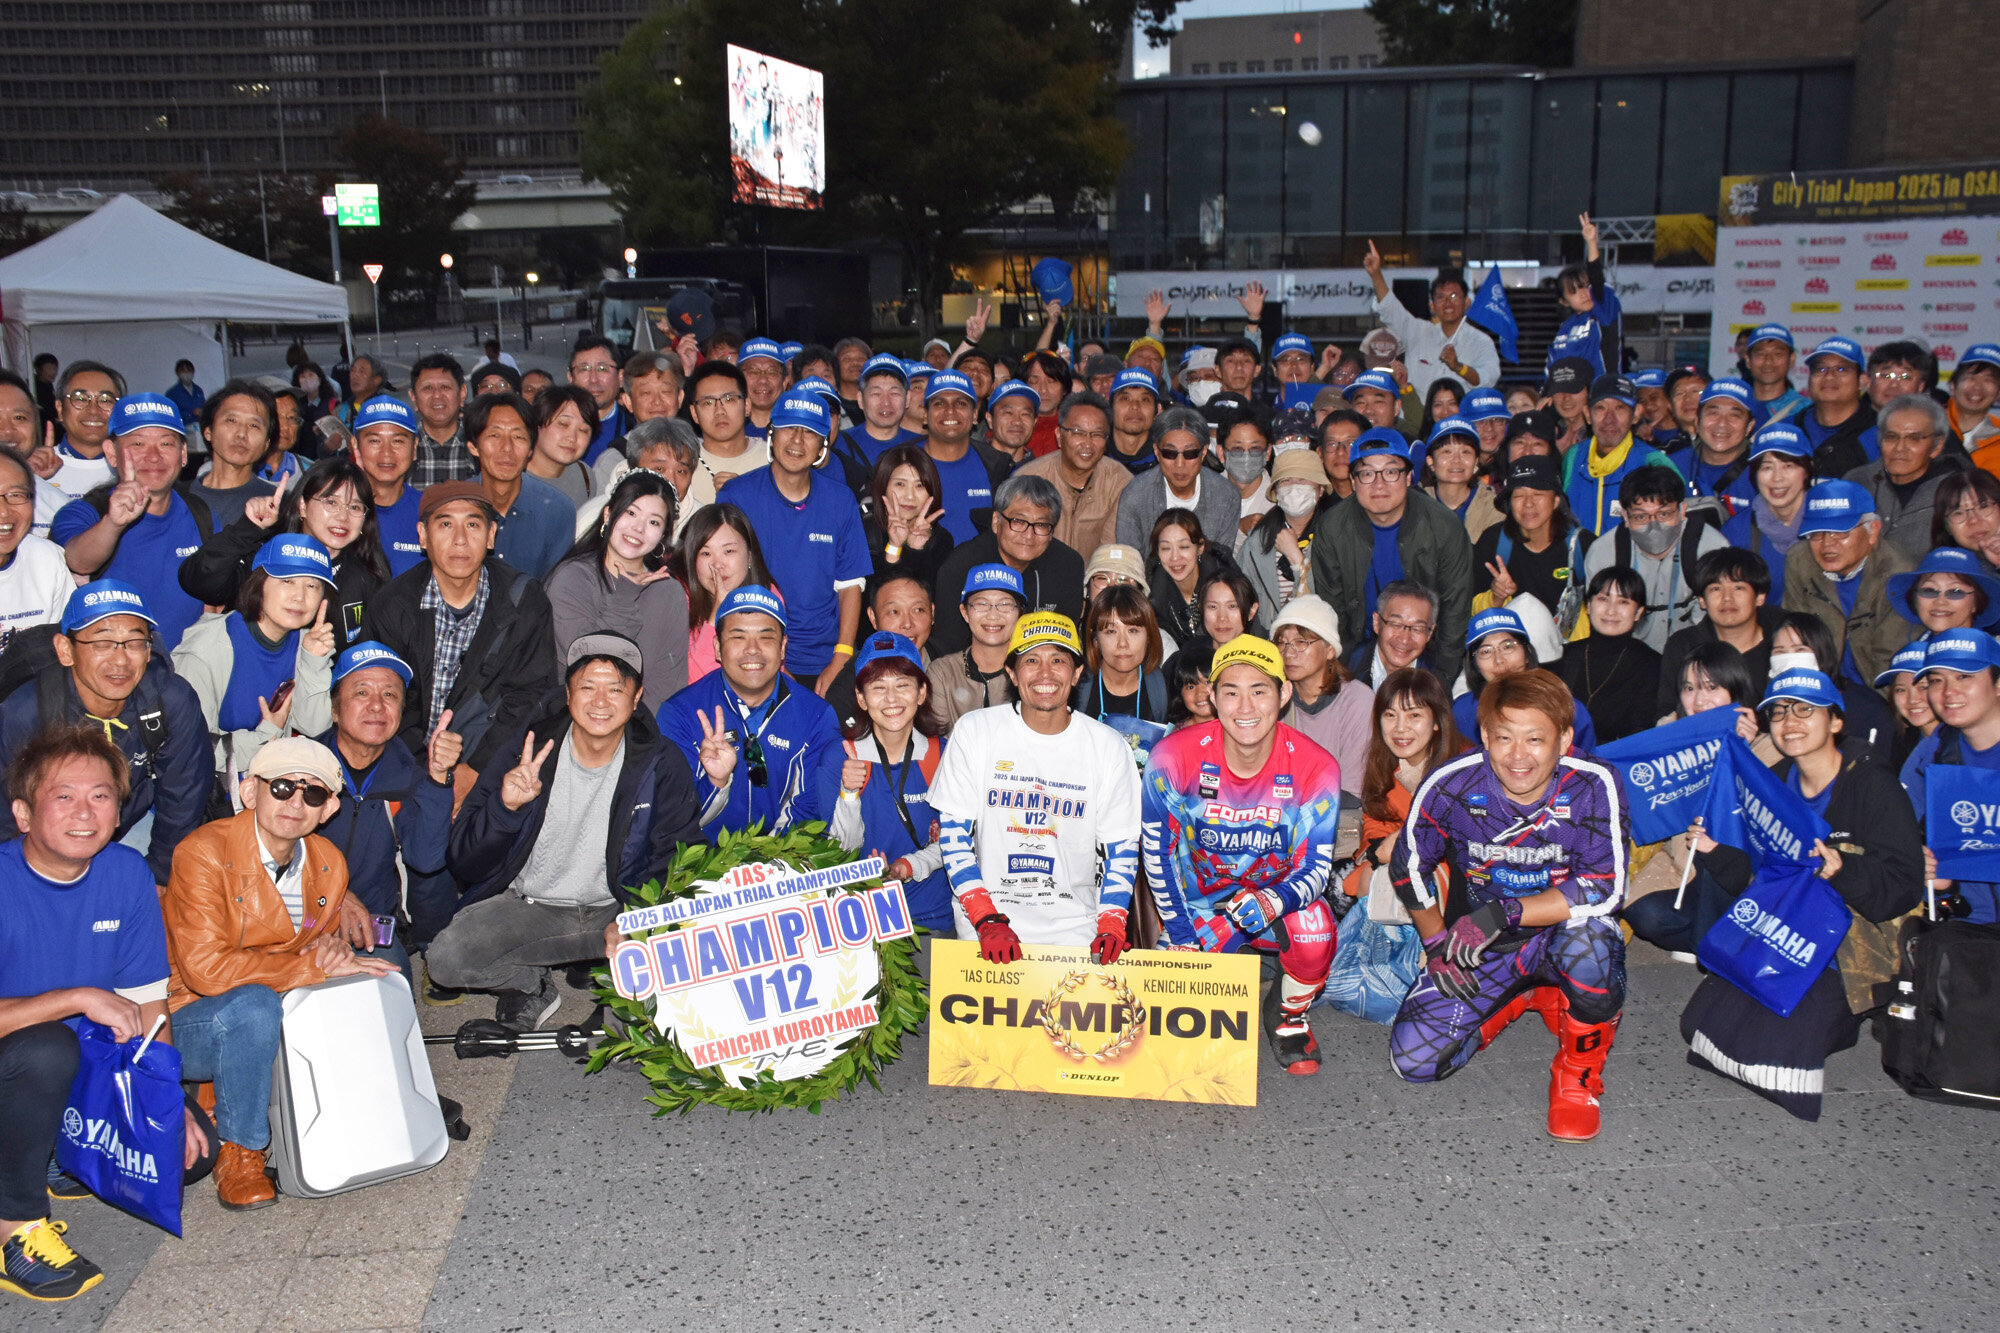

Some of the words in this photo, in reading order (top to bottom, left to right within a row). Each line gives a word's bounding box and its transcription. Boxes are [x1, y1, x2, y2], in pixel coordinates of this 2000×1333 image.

[1772, 180, 1804, 209] City
[1807, 179, 1842, 204] Trial
[1843, 177, 1895, 205] Japan
[1897, 173, 1941, 200] 2025
[1943, 174, 1960, 197] in
[753, 344, 778, 354] YAMAHA
[942, 376, 969, 387] YAMAHA
[1130, 373, 1152, 384] YAMAHA
[1720, 384, 1748, 398] YAMAHA
[136, 403, 174, 417] YAMAHA
[793, 400, 823, 415] YAMAHA
[1481, 397, 1506, 408] YAMAHA
[376, 404, 408, 417] YAMAHA
[1766, 432, 1798, 443] YAMAHA
[1816, 497, 1850, 508] YAMAHA
[294, 545, 329, 566] YAMAHA
[984, 570, 1018, 588] YAMAHA
[97, 590, 143, 607] YAMAHA
[745, 593, 779, 611] YAMAHA
[8, 609, 45, 621] CHAMPIONSHIP
[1483, 616, 1517, 627] YAMAHA
[1029, 618, 1071, 628] DUNLOP
[1935, 640, 1976, 652] YAMAHA
[1221, 650, 1275, 665] DUNLOP
[1780, 677, 1821, 689] YAMAHA
[993, 773, 1008, 781] 2025
[1010, 774, 1019, 782] ALL
[1048, 780, 1087, 792] CHAMPIONSHIP
[987, 788, 1087, 819] CHAMPION
[1025, 811, 1047, 826] V12
[1203, 803, 1281, 823] COMAS
[1742, 788, 1803, 861] YAMAHA
[1220, 829, 1282, 850] YAMAHA
[1018, 857, 1050, 871] YAMAHA
[733, 865, 766, 887] IAS
[1508, 871, 1549, 884] YAMAHA
[619, 907, 659, 932] 2025
[662, 901, 687, 922] ALL
[689, 891, 733, 915] JAPAN
[734, 880, 775, 905] TRIAL
[777, 859, 883, 896] CHAMPIONSHIP
[614, 884, 911, 999] CHAMPION
[1293, 933, 1332, 943] COMAS
[1037, 955, 1077, 964] JAPAN
[1116, 958, 1213, 971] CHAMPIONSHIP
[732, 963, 819, 1022] V12
[1143, 978, 1187, 994] KENICHI
[1189, 980, 1249, 998] KUROYAMA
[939, 993, 1249, 1042] CHAMPION
[693, 1028, 771, 1067] KENICHI
[773, 1003, 877, 1043] KUROYAMA
[1070, 1072, 1121, 1083] DUNLOP
[86, 1118, 158, 1178] YAMAHA
